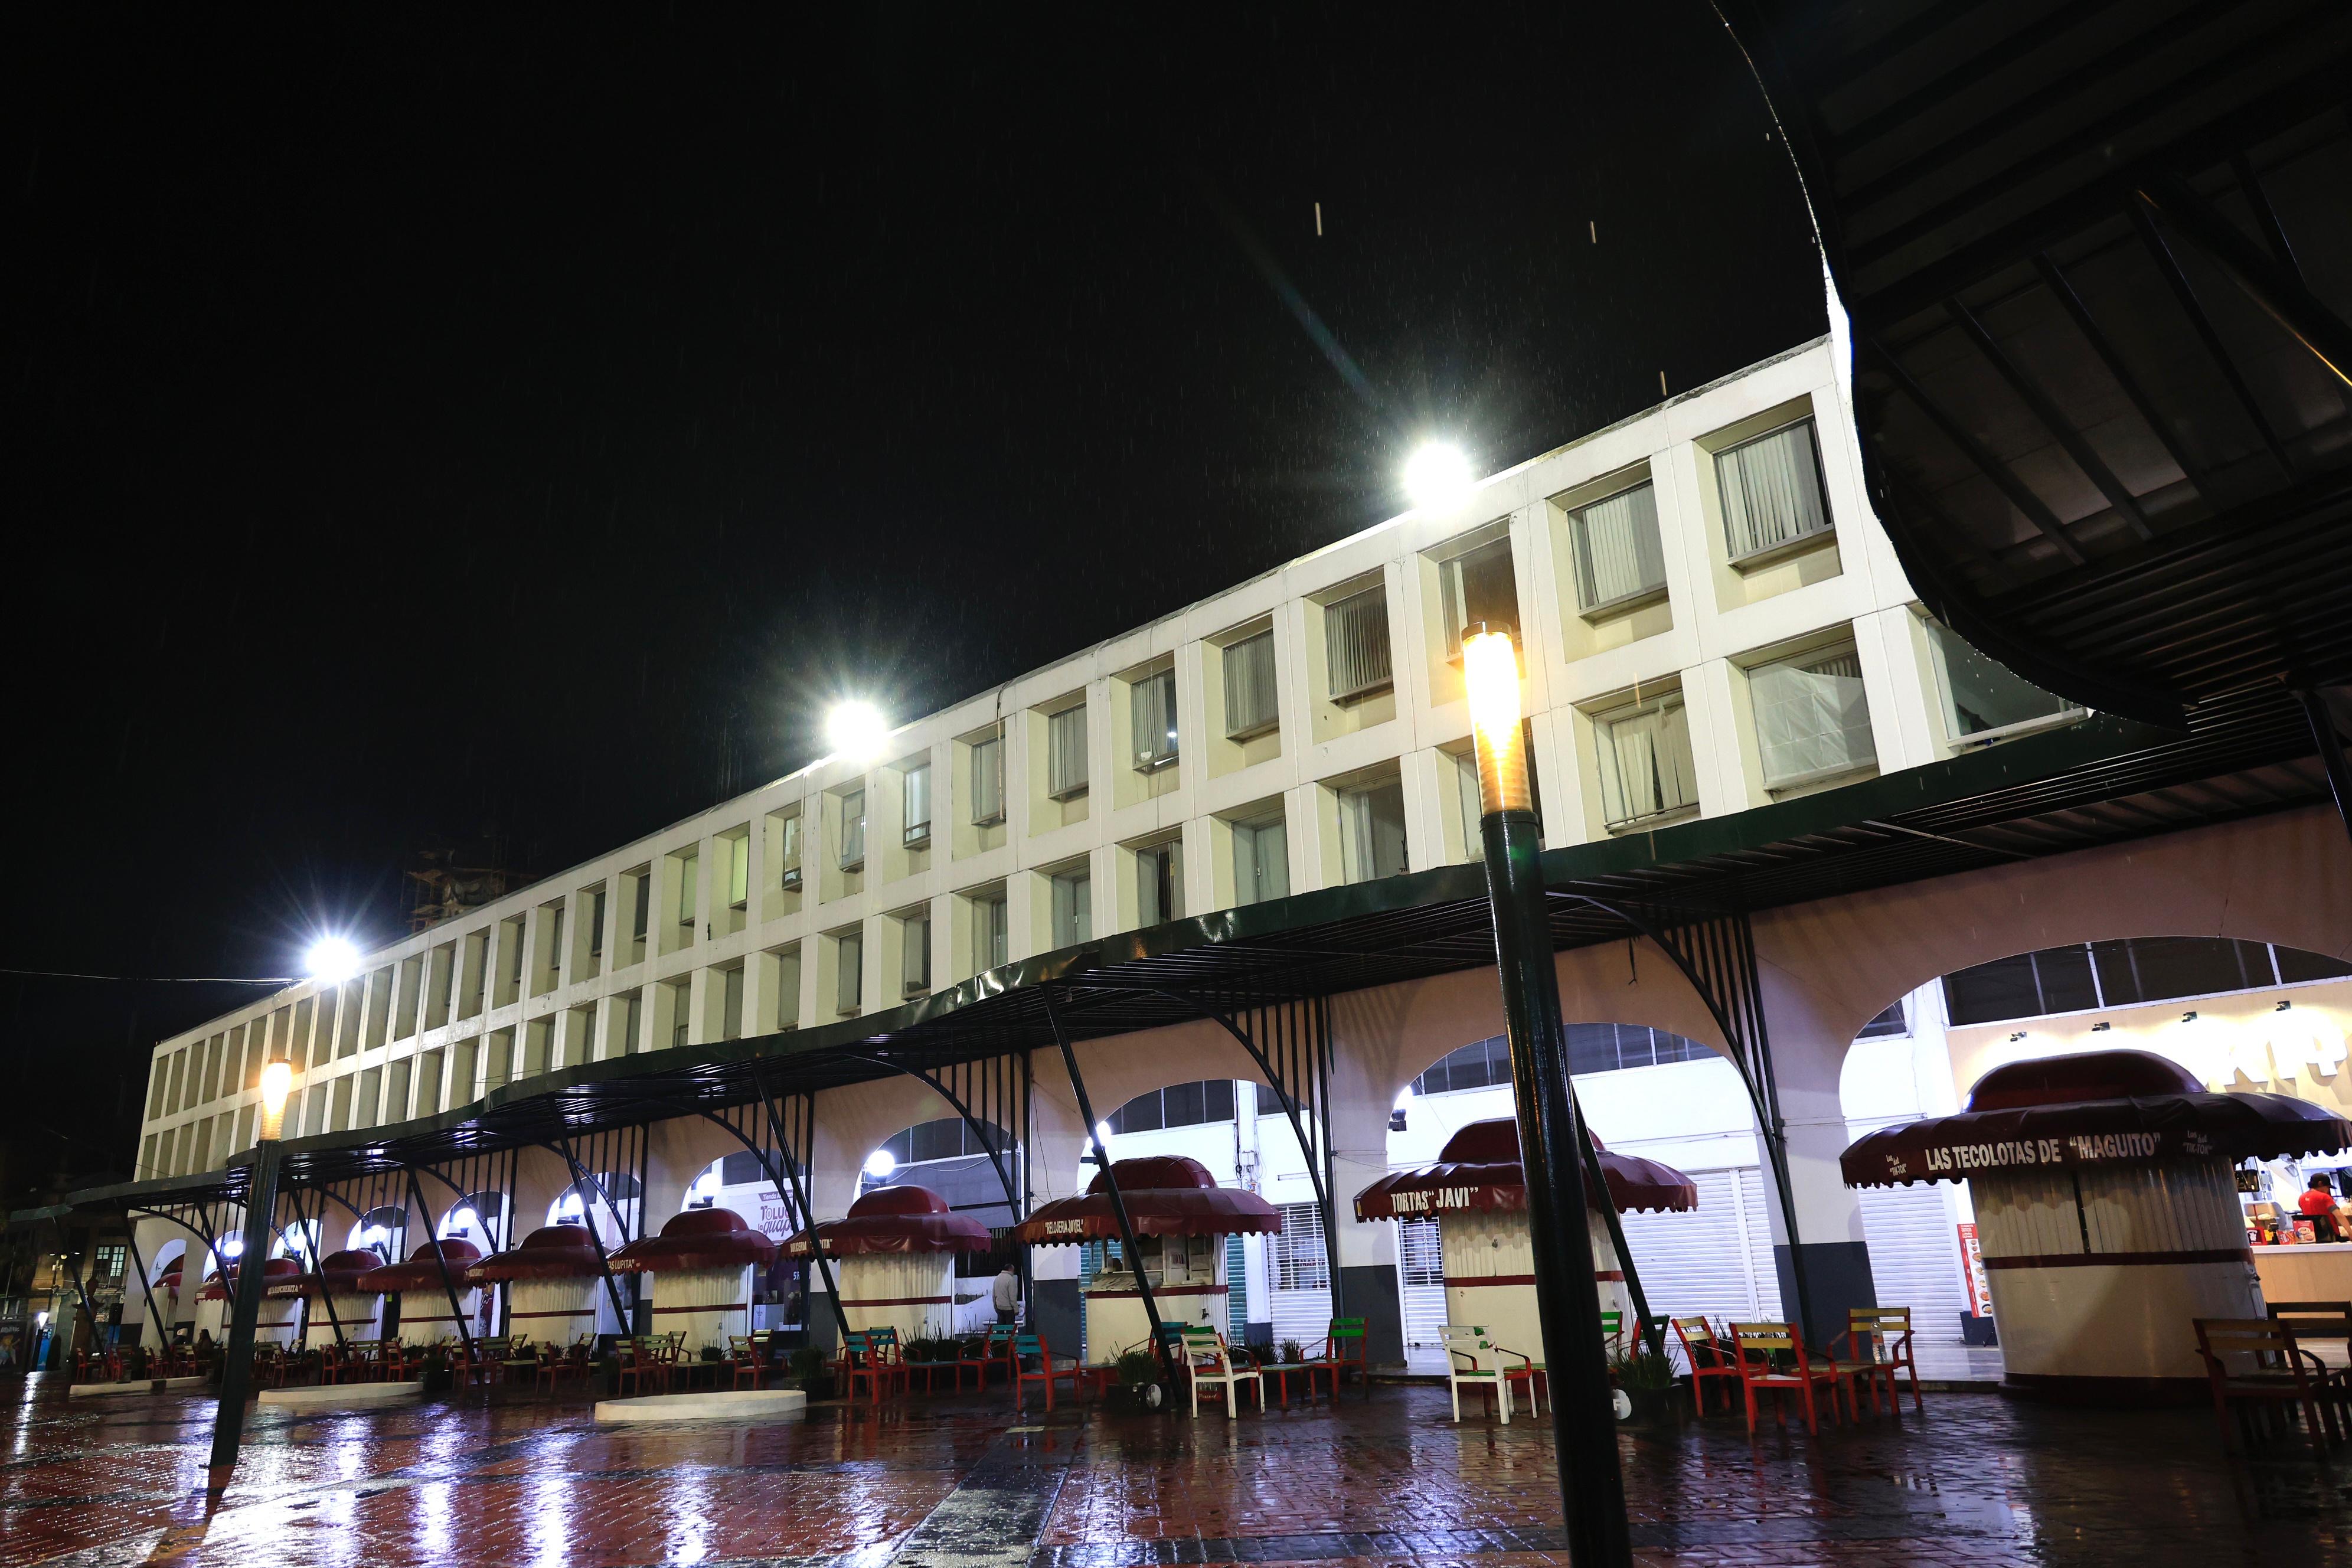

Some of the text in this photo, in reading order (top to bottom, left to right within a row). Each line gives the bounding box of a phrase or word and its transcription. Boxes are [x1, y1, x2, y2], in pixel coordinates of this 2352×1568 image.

[1925, 1132, 2161, 1171] LAS TECOLOTAS DE "MAGUITO"
[1390, 1191, 1429, 1213] TORTAS
[760, 1205, 798, 1221] TOLUC
[763, 1218, 800, 1237] guap
